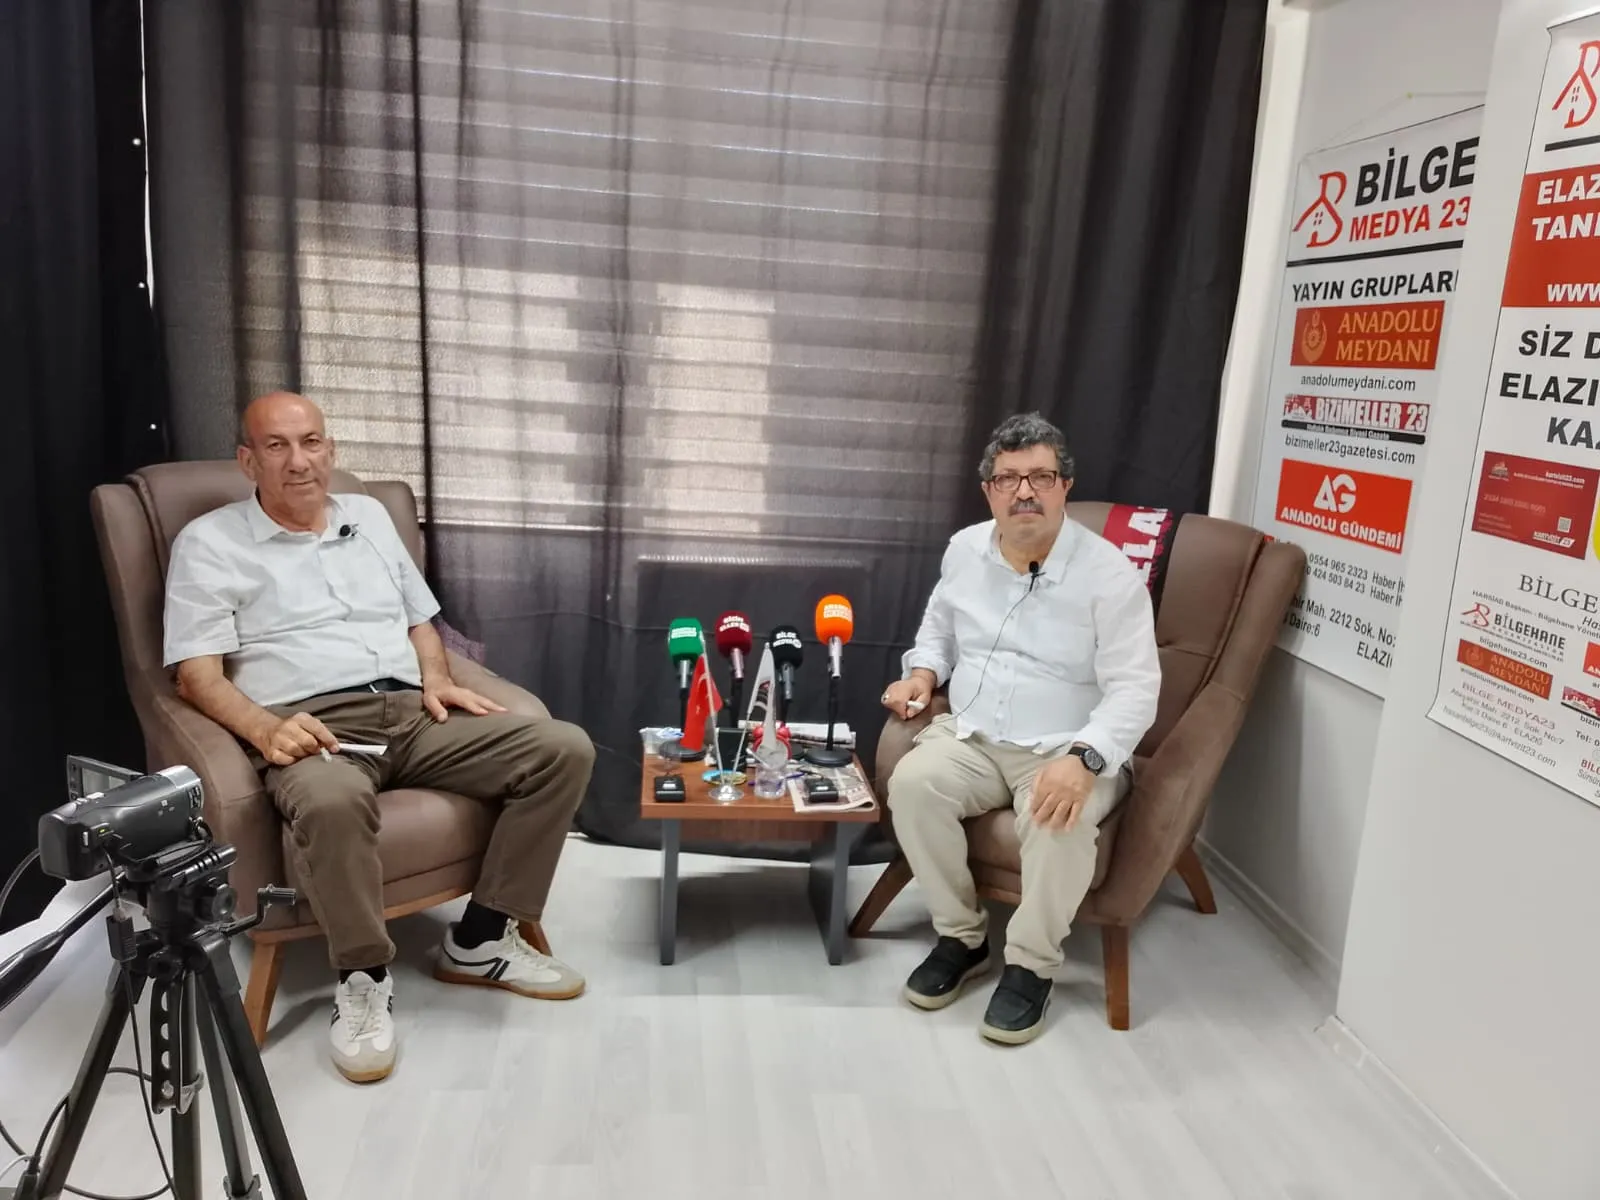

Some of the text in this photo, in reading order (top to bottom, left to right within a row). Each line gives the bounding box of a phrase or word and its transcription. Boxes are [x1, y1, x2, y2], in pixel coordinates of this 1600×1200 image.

[1354, 136, 1480, 207] BİLGE
[1349, 196, 1471, 242] MEDYA 23
[1292, 280, 1344, 302] YAYIN
[1338, 308, 1439, 334] ANADOLU
[1335, 339, 1431, 363] MEYDANI
[1518, 324, 1573, 358] SİZ
[1300, 373, 1416, 392] anadolumeydani.com
[1405, 404, 1428, 432] 23
[1546, 416, 1600, 450] KA
[1285, 433, 1416, 464] bizimeller23gazetesi.com
[1313, 473, 1357, 513] AG
[1280, 506, 1402, 550] ANADOLU GÜNDEMİ
[1309, 552, 1328, 567] 0554
[1331, 559, 1346, 573] 965
[1347, 564, 1368, 580] 2323
[1372, 570, 1396, 589] Haber
[1313, 567, 1327, 580] 424
[1355, 581, 1365, 594] 23
[1370, 586, 1395, 605] Haber
[1518, 574, 1598, 614] BİLGE
[1306, 599, 1326, 620] Mah.
[1329, 608, 1352, 630] 2212
[1354, 617, 1375, 639] Sok.
[1495, 613, 1566, 650] BİLGEHANE
[1356, 641, 1393, 669] ELAZI
[1491, 654, 1549, 685] ANADOLU
[1488, 666, 1545, 696] MEYDANI
